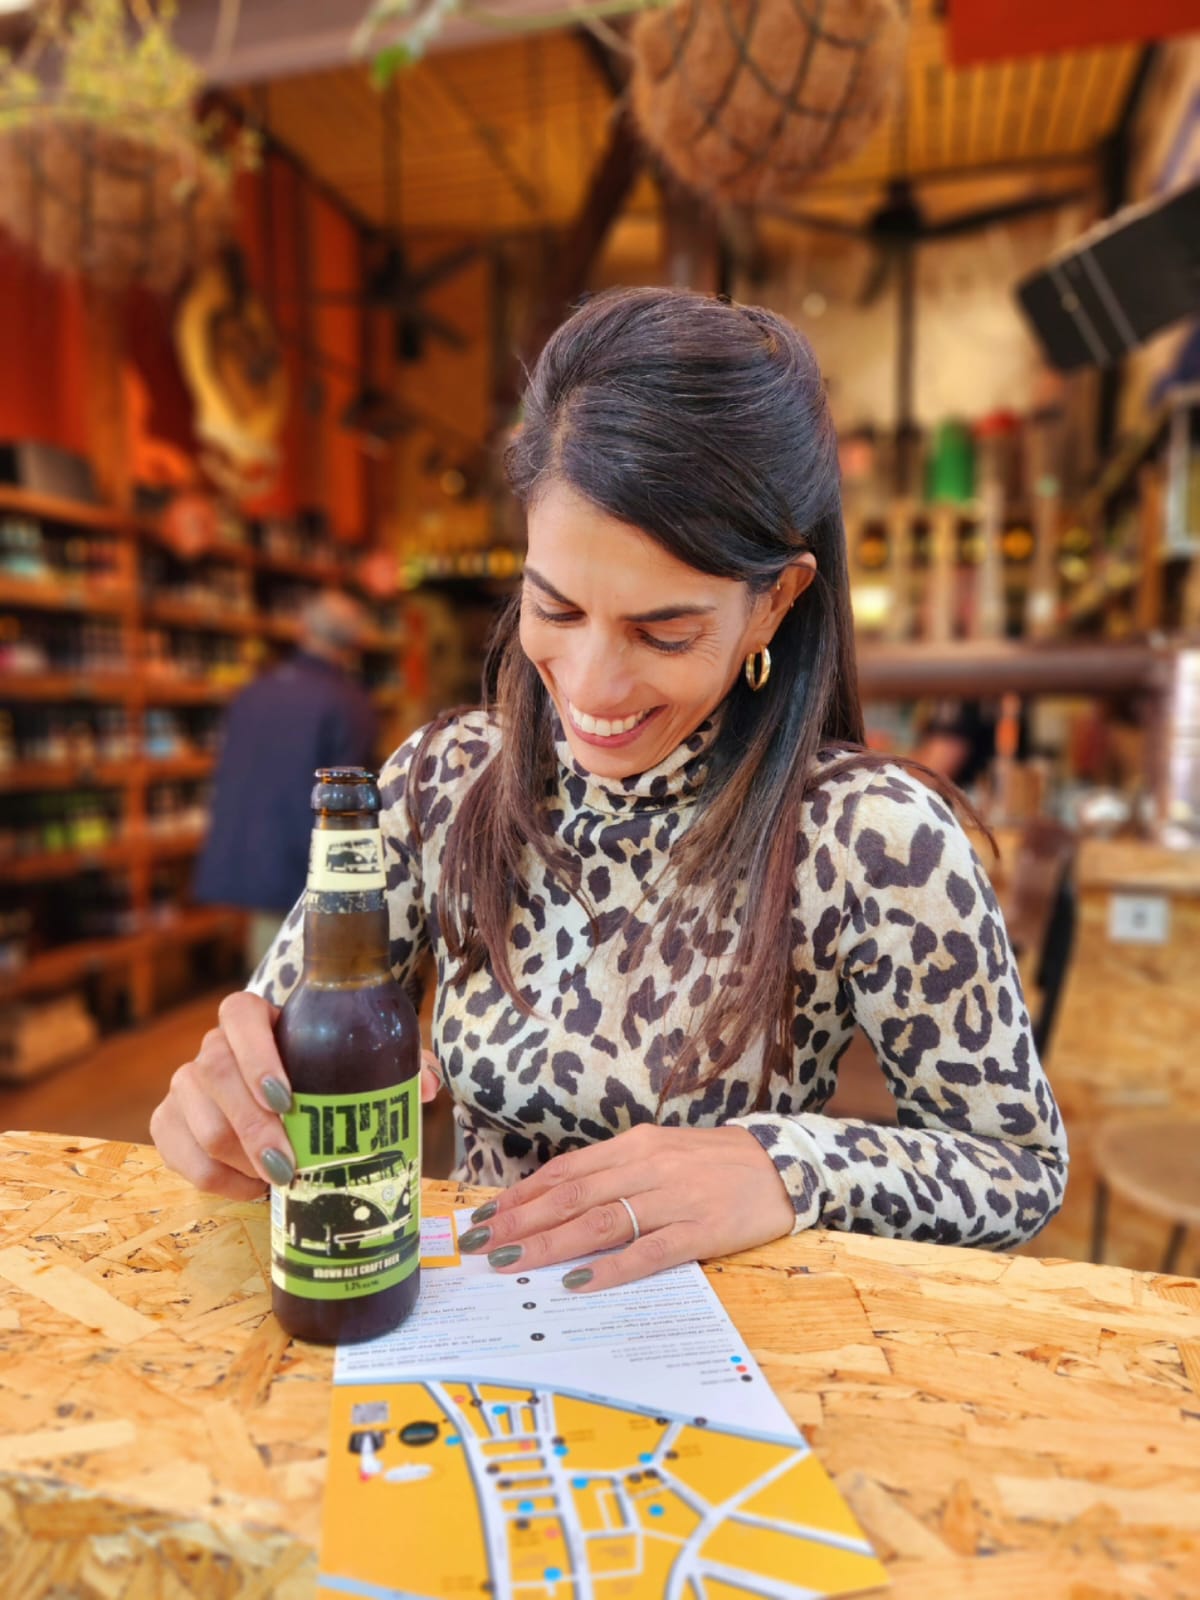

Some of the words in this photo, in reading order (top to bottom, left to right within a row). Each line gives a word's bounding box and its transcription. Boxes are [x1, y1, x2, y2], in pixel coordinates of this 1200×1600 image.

[300, 1091, 409, 1155] הגיבור
[313, 1268, 342, 1278] BROWN
[344, 1266, 358, 1277] ALE
[360, 1259, 383, 1275] CRAFT
[384, 1252, 400, 1268] BEER
